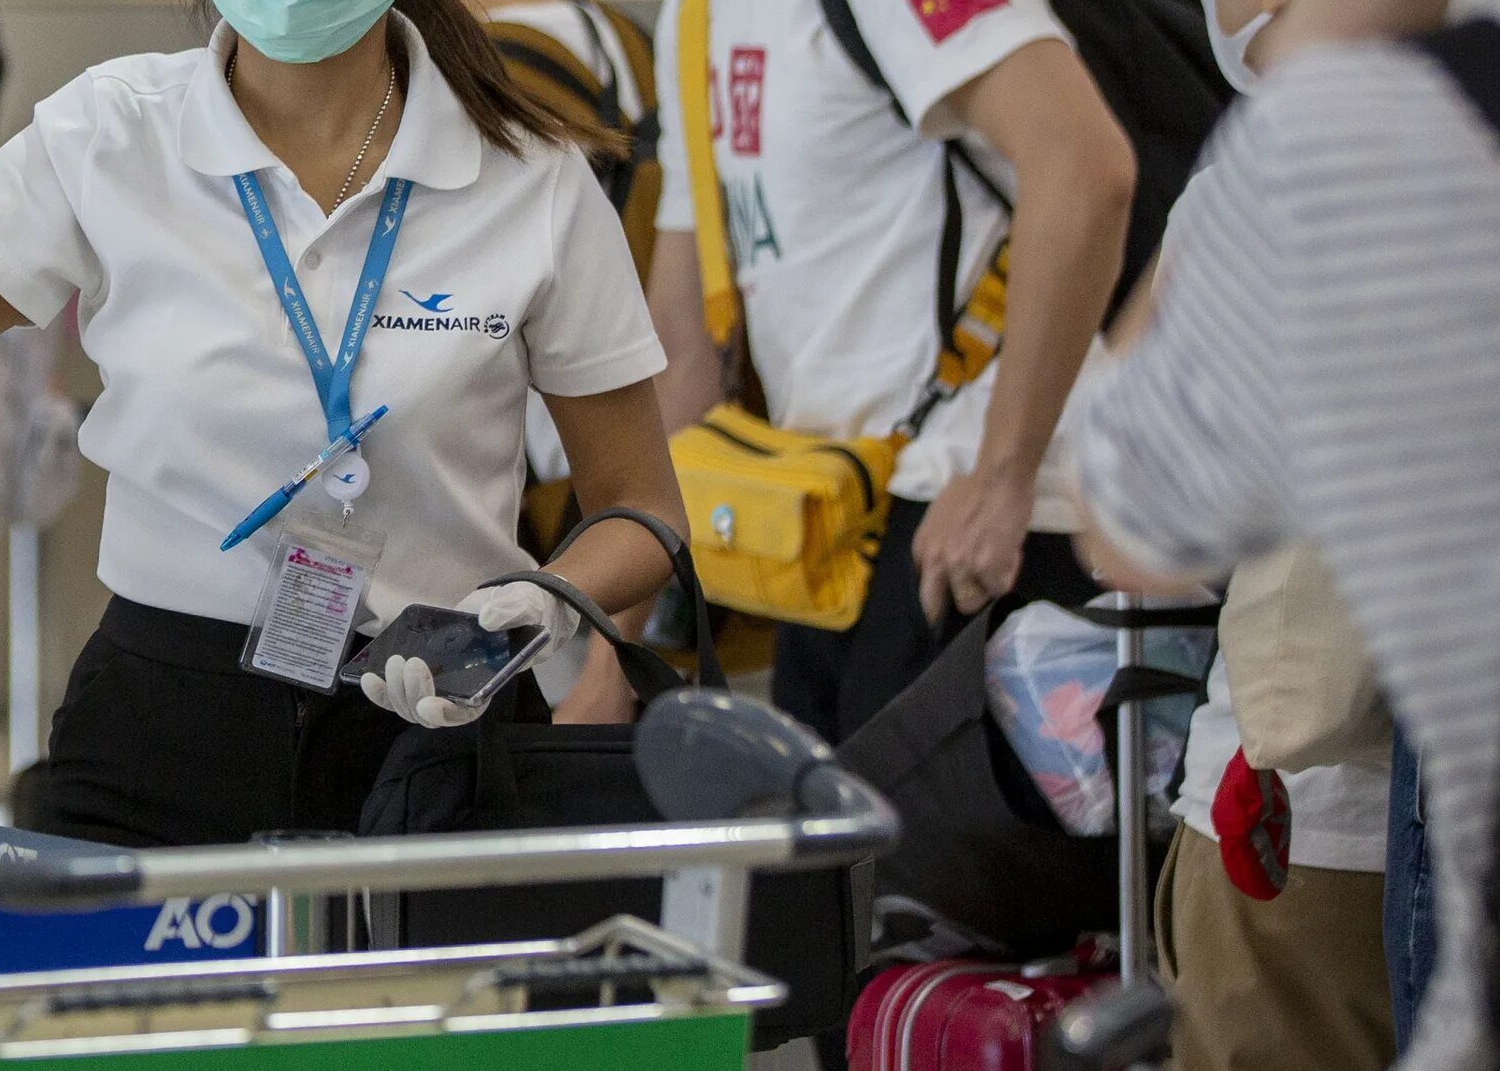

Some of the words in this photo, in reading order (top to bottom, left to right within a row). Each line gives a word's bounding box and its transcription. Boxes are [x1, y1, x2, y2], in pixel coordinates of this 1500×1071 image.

[291, 301, 320, 354] XIAMENAIR
[348, 293, 371, 347] XIAMENAIR
[371, 314, 480, 332] XIAMENAIR
[143, 892, 257, 951] AO
